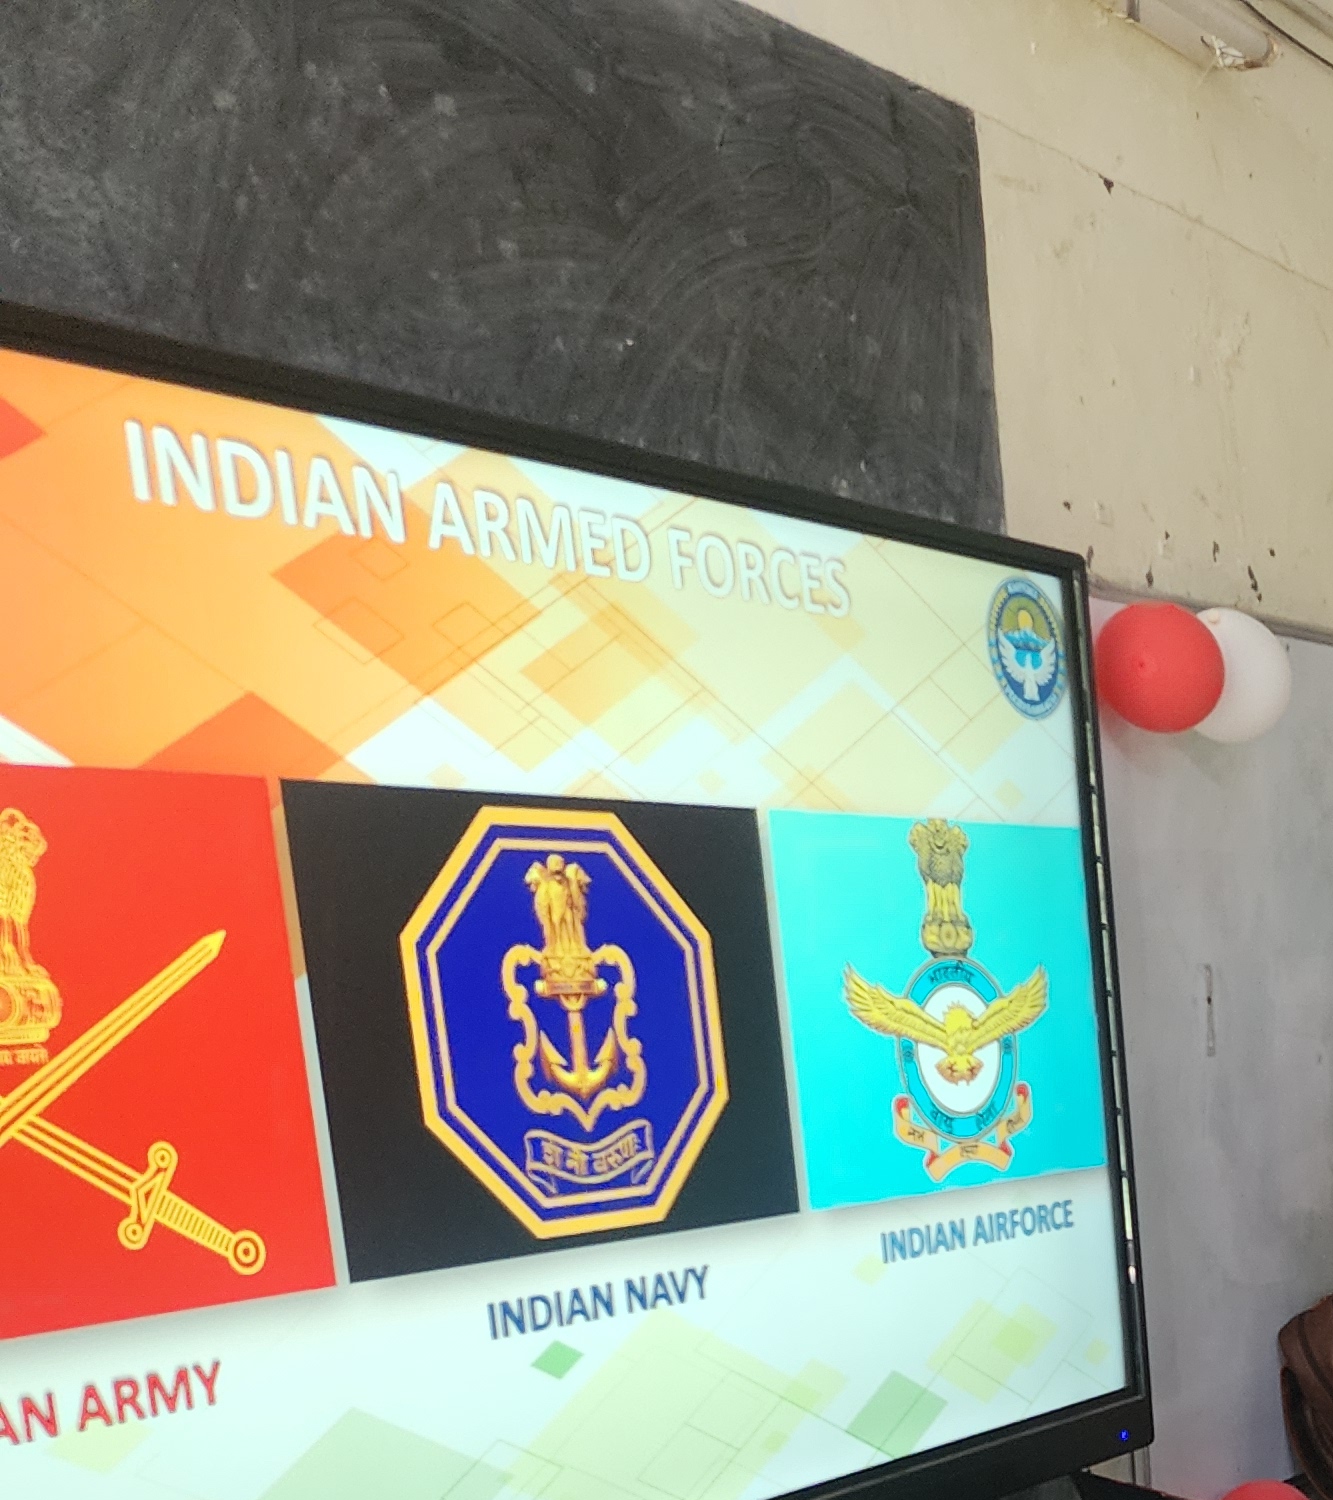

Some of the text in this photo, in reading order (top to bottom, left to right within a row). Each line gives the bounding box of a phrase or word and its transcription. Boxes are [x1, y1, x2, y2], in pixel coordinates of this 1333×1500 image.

[123, 418, 852, 619] INDIAN ARMED FORCES
[880, 1199, 1076, 1264] INDIAN AIRFORCE
[486, 1265, 710, 1341] INDIAN NAVY
[77, 1358, 221, 1433] ARMY
